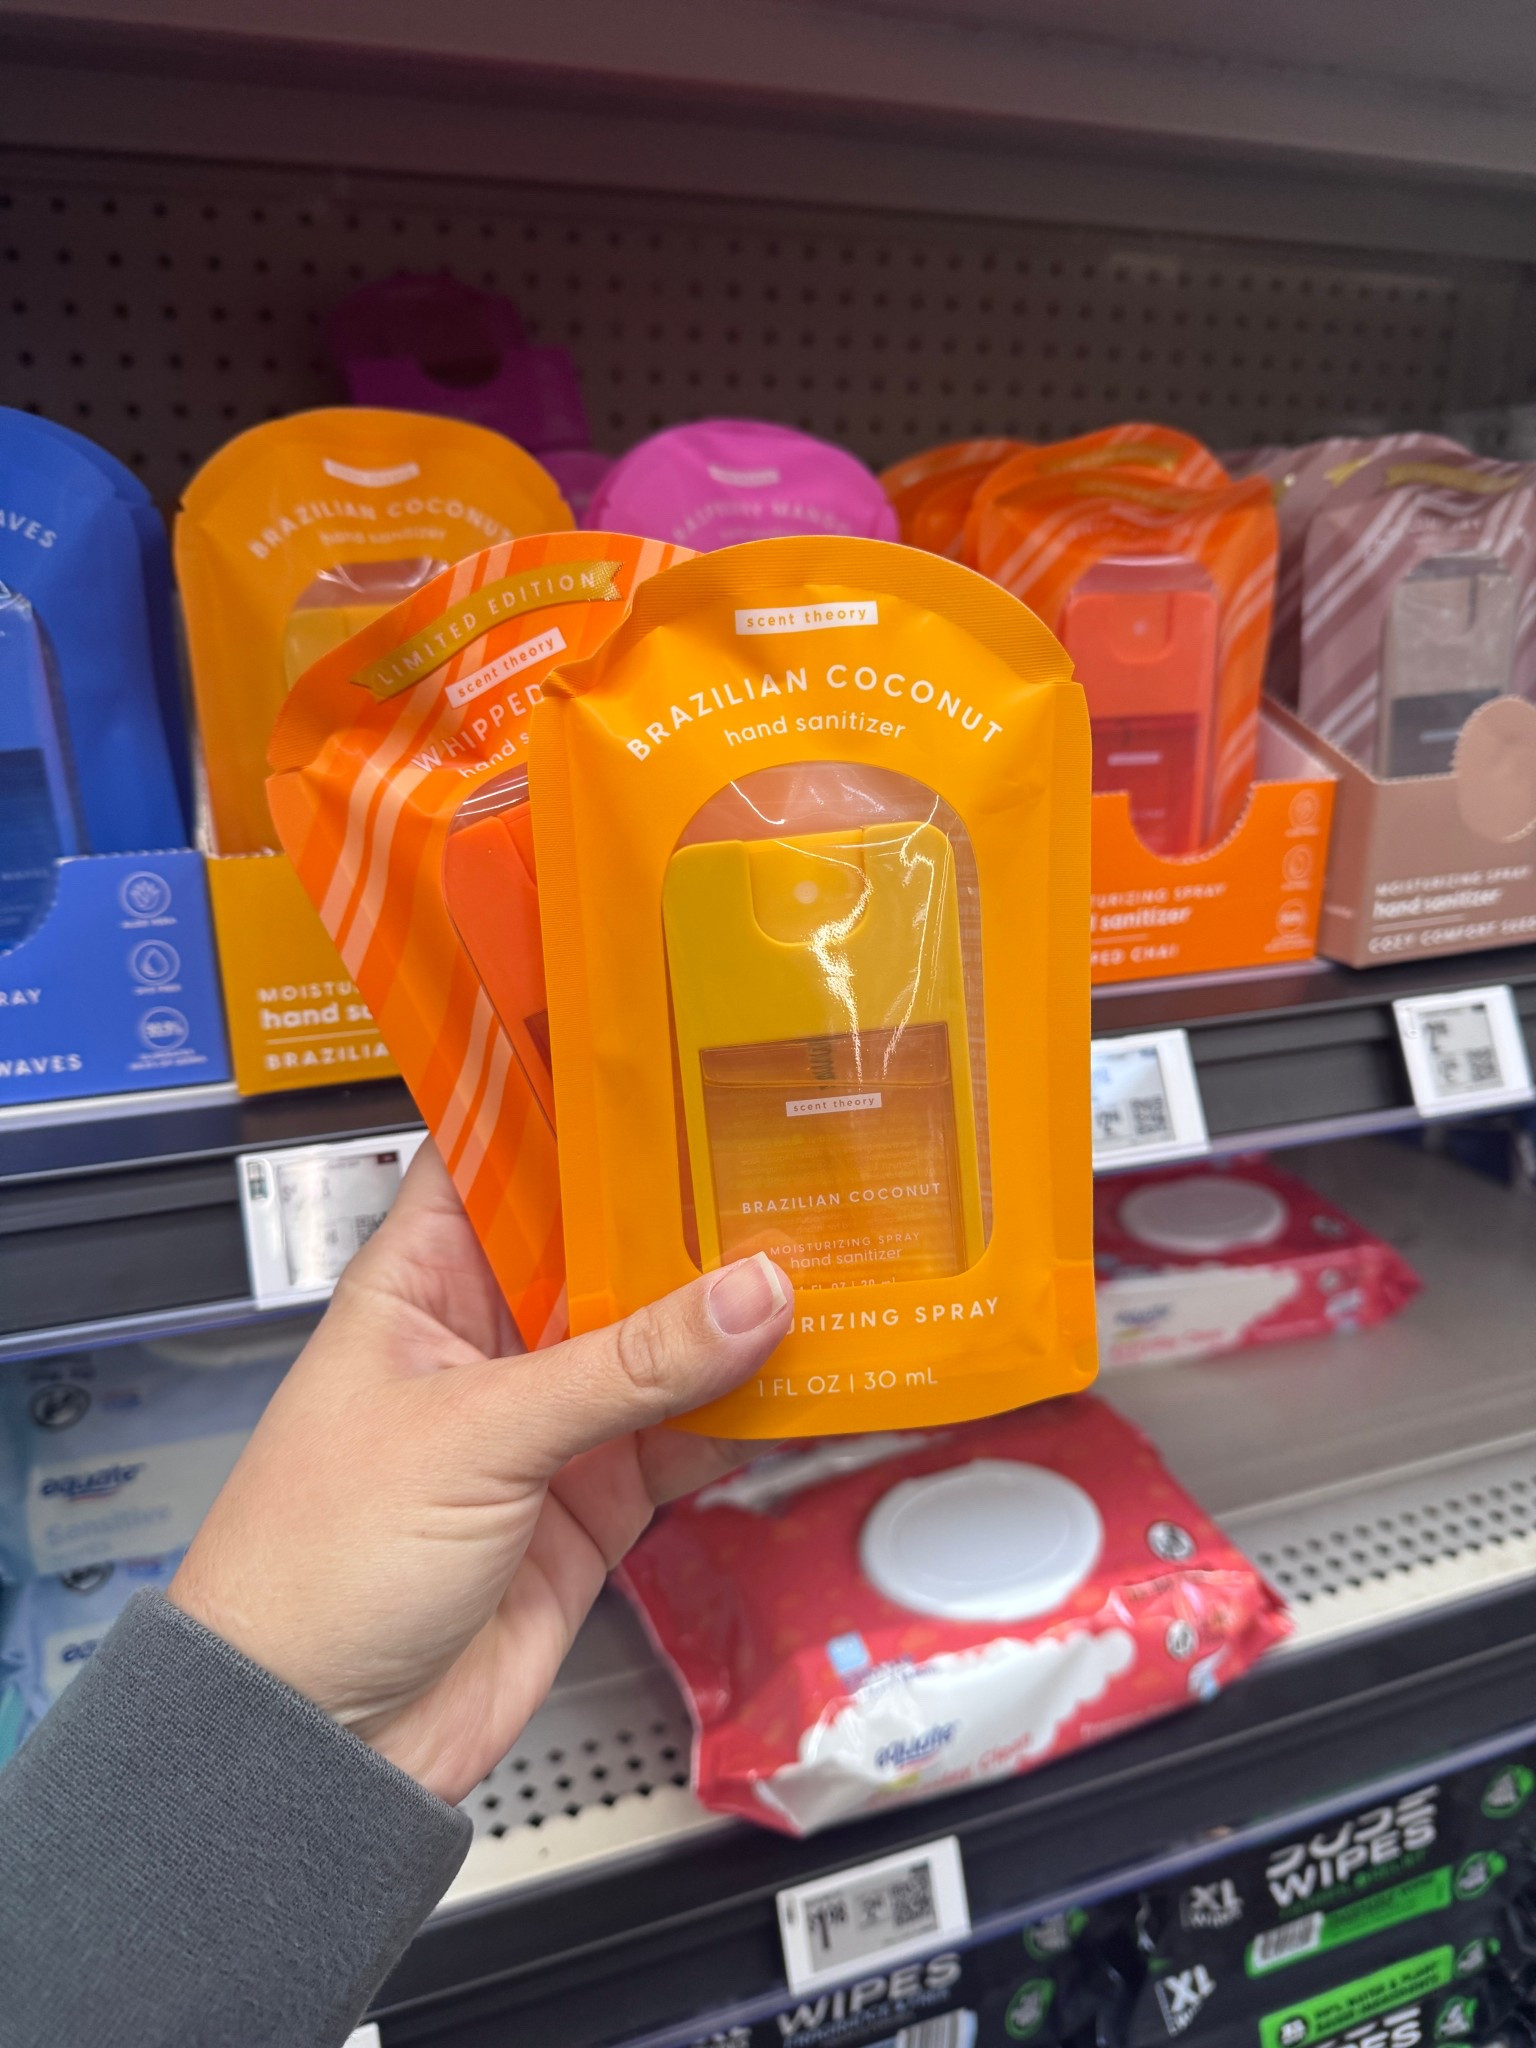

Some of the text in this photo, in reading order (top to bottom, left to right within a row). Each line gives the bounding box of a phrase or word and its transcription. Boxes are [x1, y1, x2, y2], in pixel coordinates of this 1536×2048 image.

[249, 500, 377, 559] BRAZILIAN
[377, 571, 596, 686] LIMITED EDITION
[746, 606, 867, 628] scent theory
[457, 637, 555, 698] scent theory
[411, 683, 545, 773] WHIPPED
[626, 664, 1004, 762] BRAZILIAN COCONUT
[724, 710, 906, 747] hand sanitizer
[459, 737, 516, 778] hand
[1173, 882, 1227, 902] SPRAY
[1373, 895, 1421, 919] hand
[1424, 888, 1502, 913] sanitizer
[1099, 905, 1193, 932] sanitizer
[257, 980, 360, 1003] MOISTU
[260, 1001, 340, 1030] hand
[793, 1096, 876, 1112] scent theory
[742, 1182, 941, 1214] BRAZILIAN COCONUT
[770, 1231, 920, 1256] MOISTURIZING SPRAY
[790, 1247, 903, 1269] hand sanitizer
[915, 1297, 999, 1324] SPRAY
[757, 1379, 764, 1397] 1
[774, 1379, 797, 1397] FL
[808, 1375, 841, 1395] OZ
[864, 1370, 896, 1390] 30
[906, 1367, 939, 1387] mL
[1269, 1818, 1438, 1908] WIPES
[777, 1953, 962, 2036] WIPES
